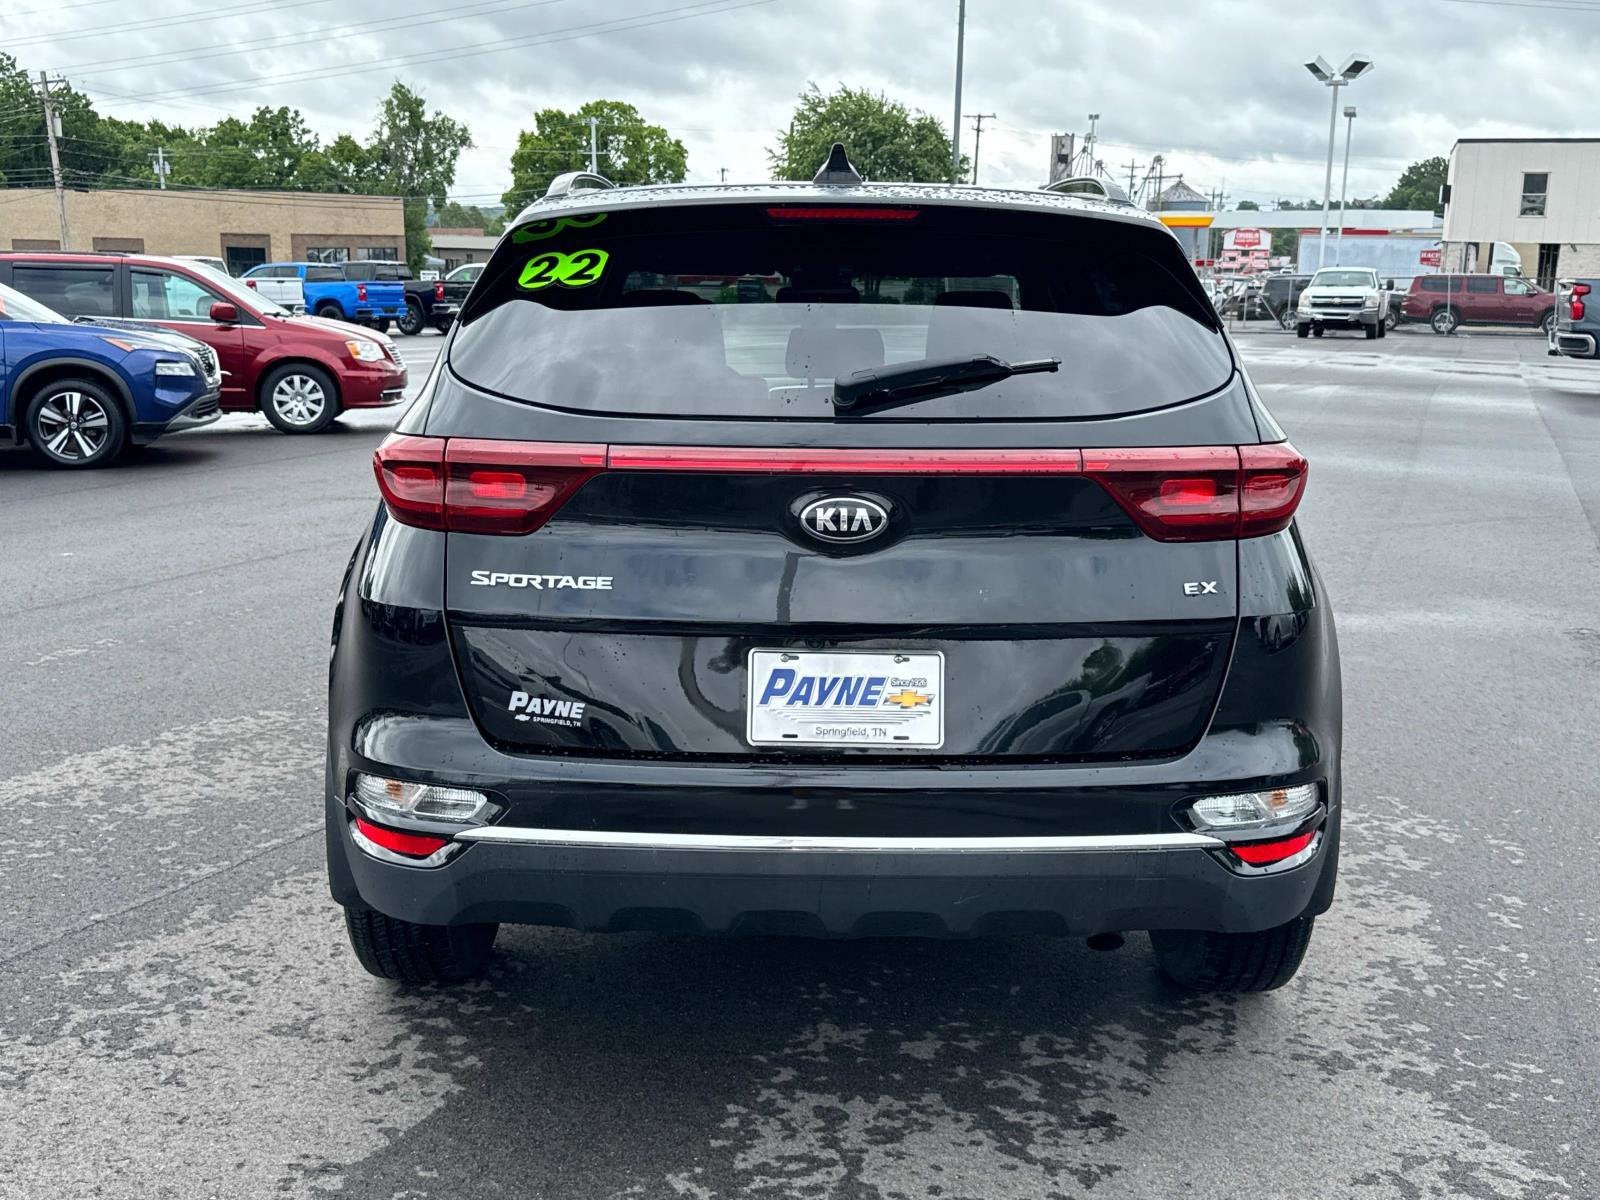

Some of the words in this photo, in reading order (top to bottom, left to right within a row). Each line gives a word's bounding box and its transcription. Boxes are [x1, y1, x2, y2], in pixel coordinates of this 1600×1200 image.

[521, 252, 603, 286] 22
[815, 507, 873, 532] KIA
[470, 570, 613, 590] SPORTAGE
[1183, 580, 1218, 595] EX
[871, 727, 887, 737] TN
